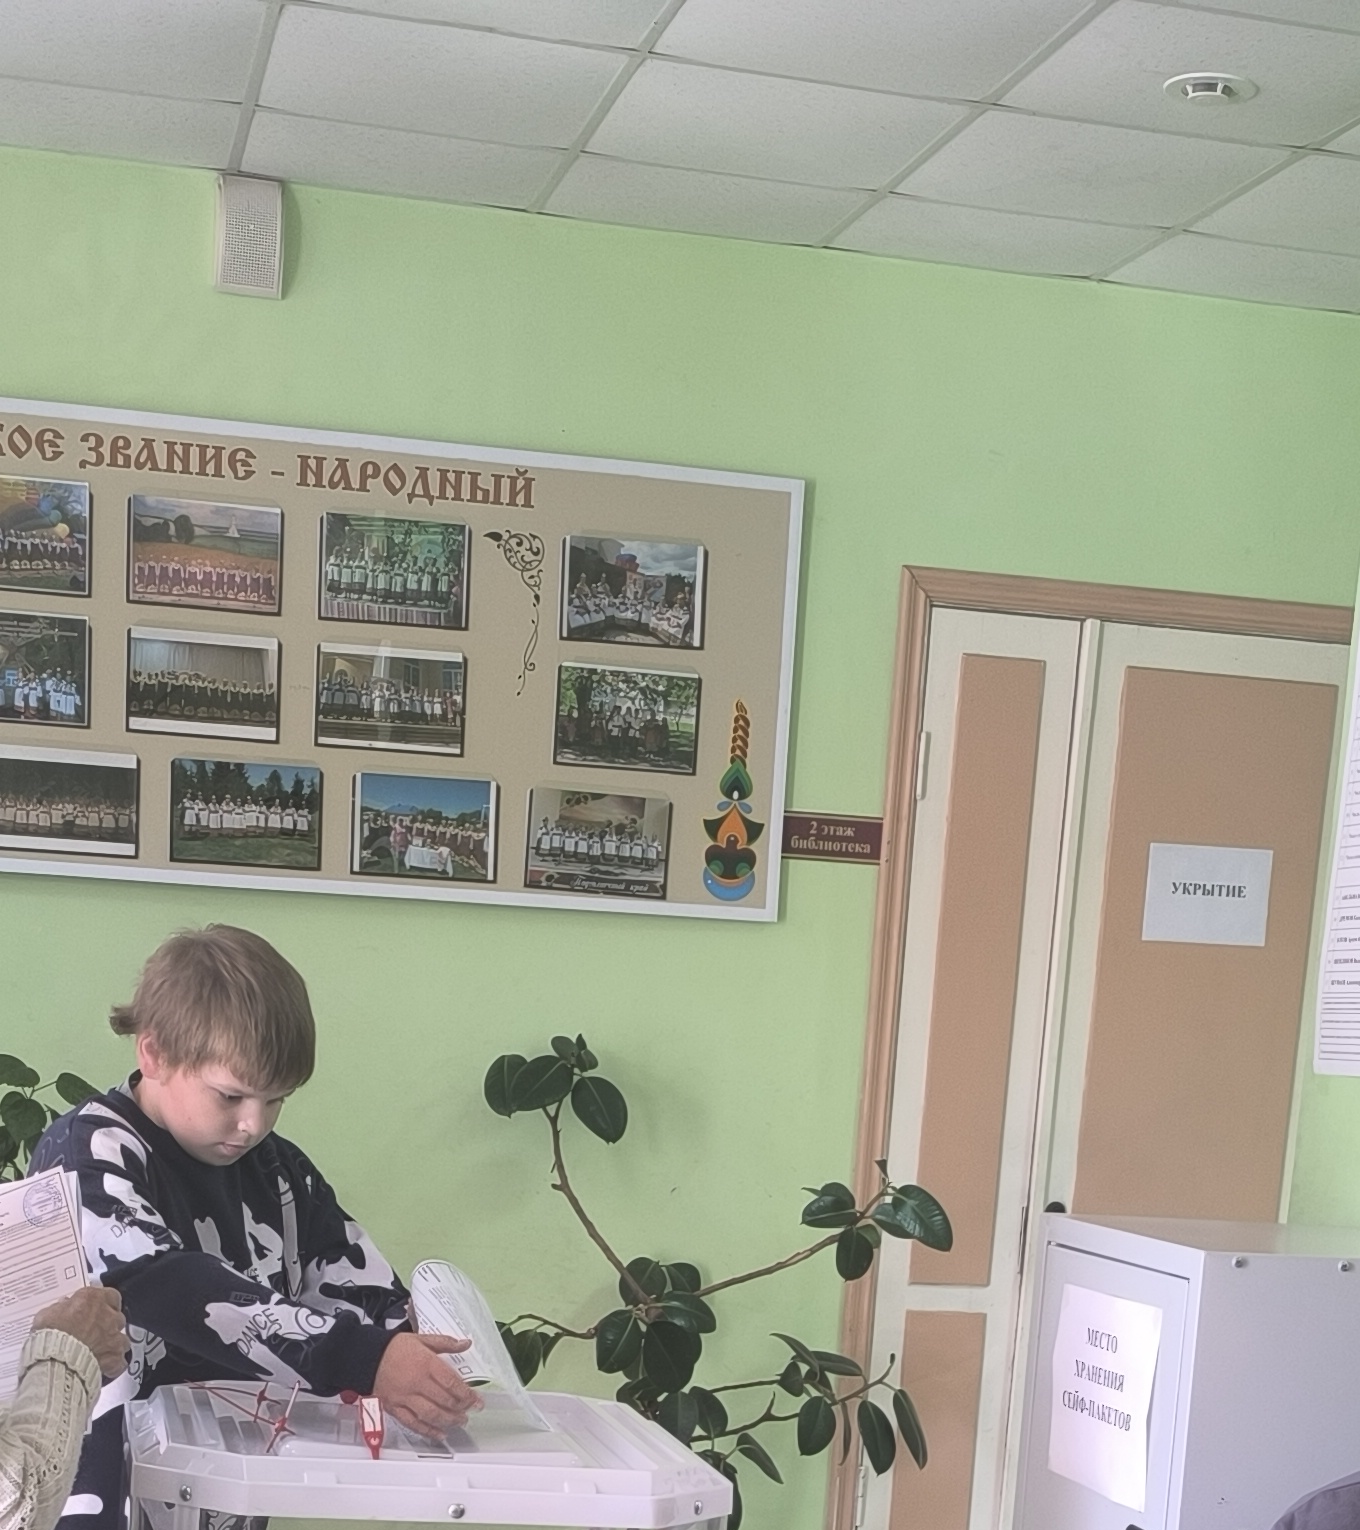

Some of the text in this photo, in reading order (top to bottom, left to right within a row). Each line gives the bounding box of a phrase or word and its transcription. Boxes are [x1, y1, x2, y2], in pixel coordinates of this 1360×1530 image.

[78, 432, 257, 481] ЗВАНИЕ
[296, 453, 537, 509] НАРОДНЫЙ
[790, 835, 871, 853] библиотека
[809, 821, 856, 837] 2 этаж
[1171, 881, 1247, 899] УКРЫТИЕ
[235, 1307, 280, 1357] DANCE
[1086, 1327, 1118, 1354] МЕСТО
[1073, 1359, 1125, 1393] ХРАНЕНИЯ
[1062, 1389, 1132, 1431] СЕЙФ-ПАКЕТОВ
